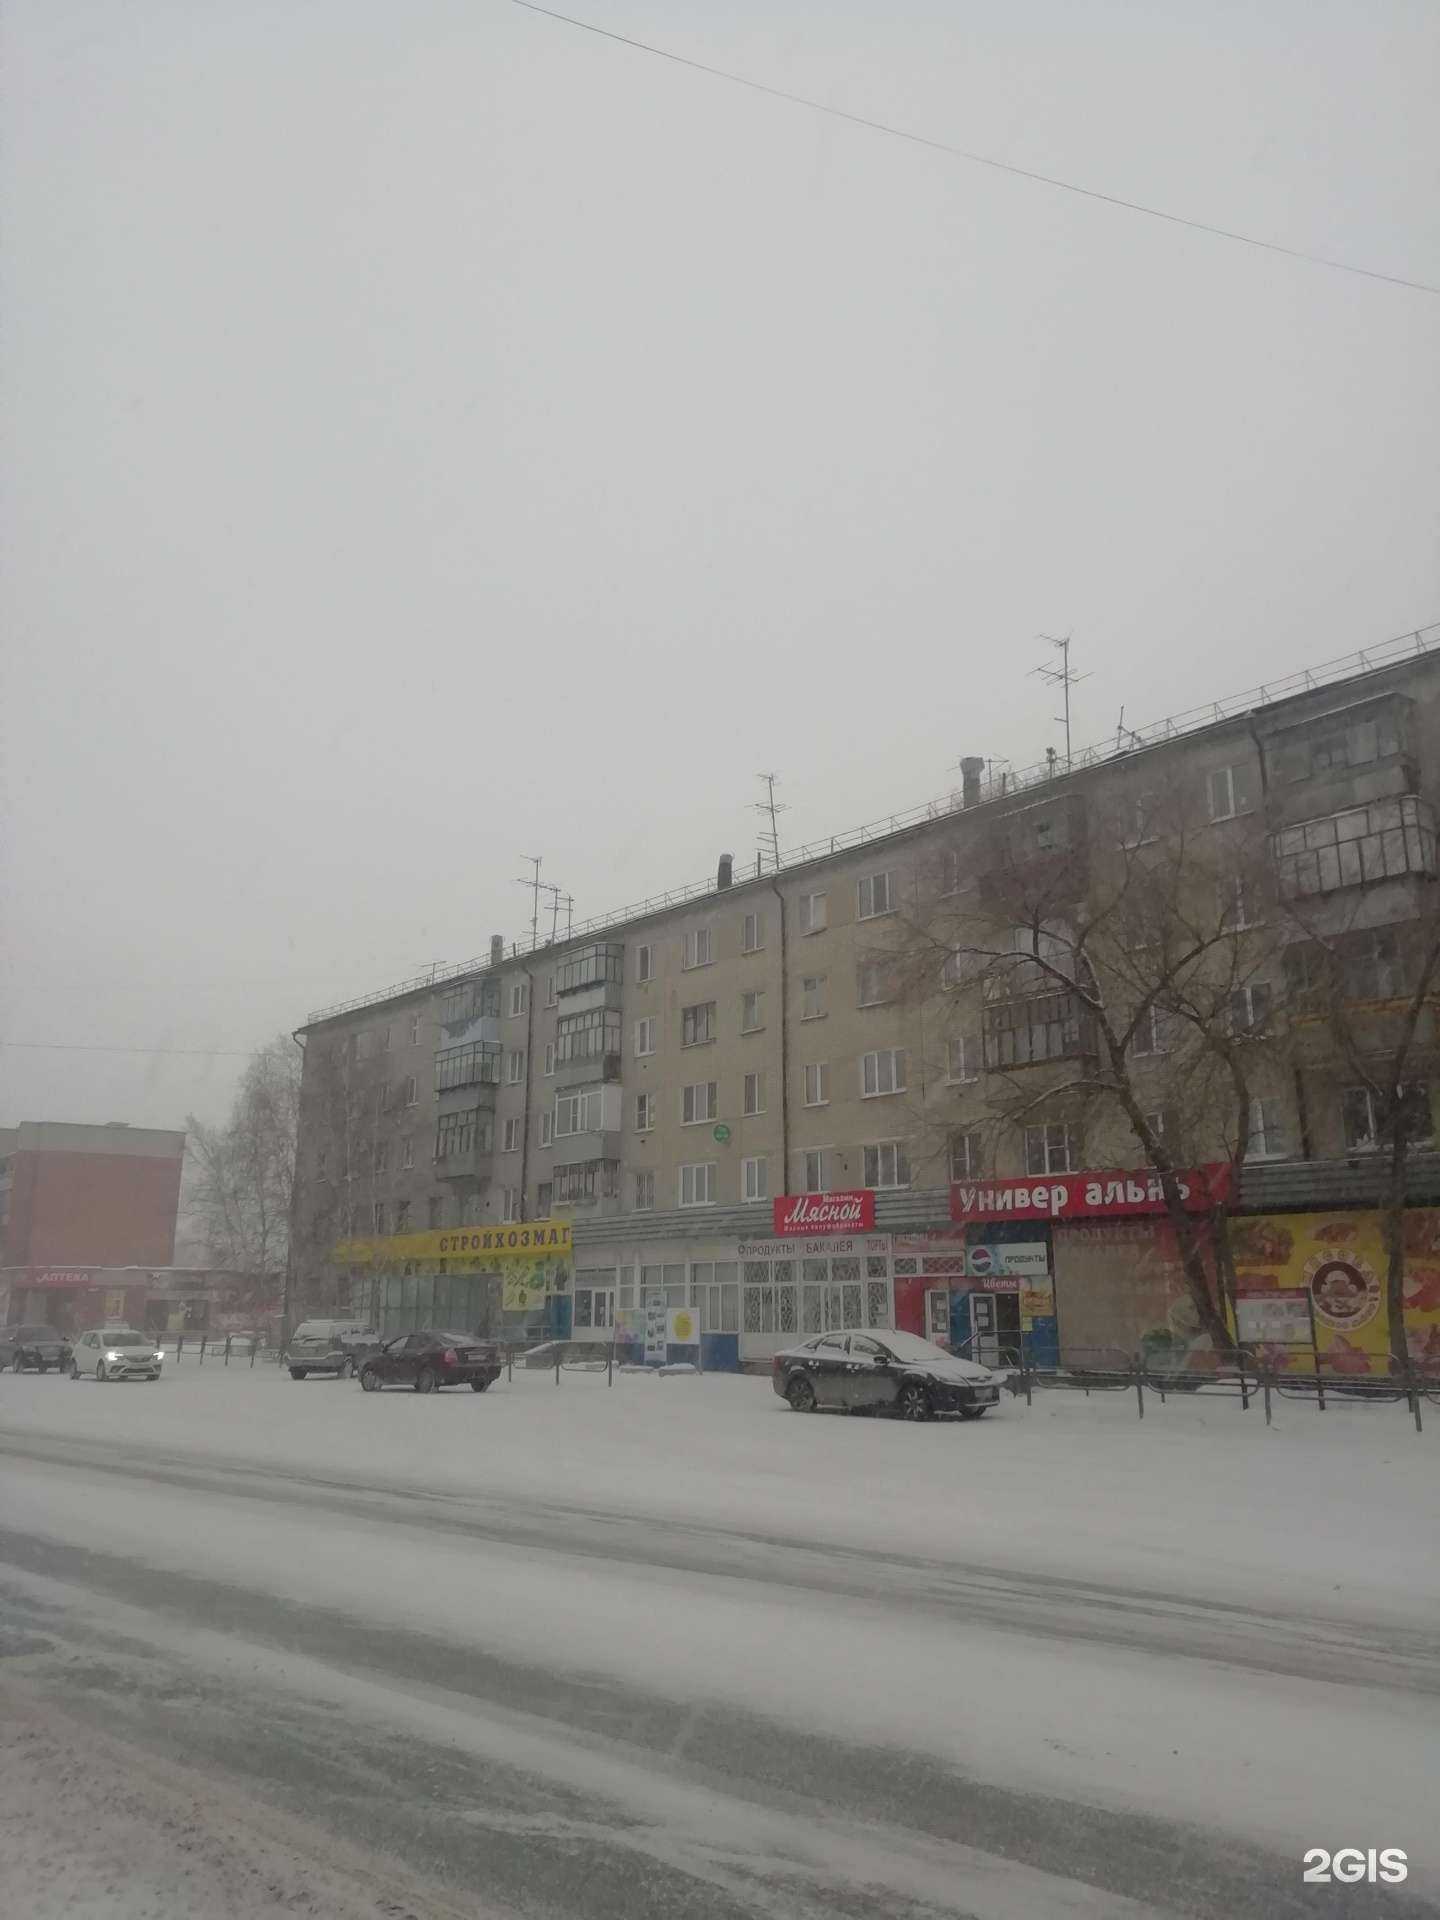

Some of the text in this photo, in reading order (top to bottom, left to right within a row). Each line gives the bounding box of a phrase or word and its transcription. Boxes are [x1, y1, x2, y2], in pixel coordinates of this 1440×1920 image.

[784, 1196, 863, 1223] Мясной
[439, 1227, 570, 1252] СТРОЙХОЗМАГ
[746, 1243, 795, 1256] ПРОДУКТЫ
[1005, 1254, 1046, 1264] ПРОДУКТЫ
[36, 1272, 89, 1283] АПТЕКА
